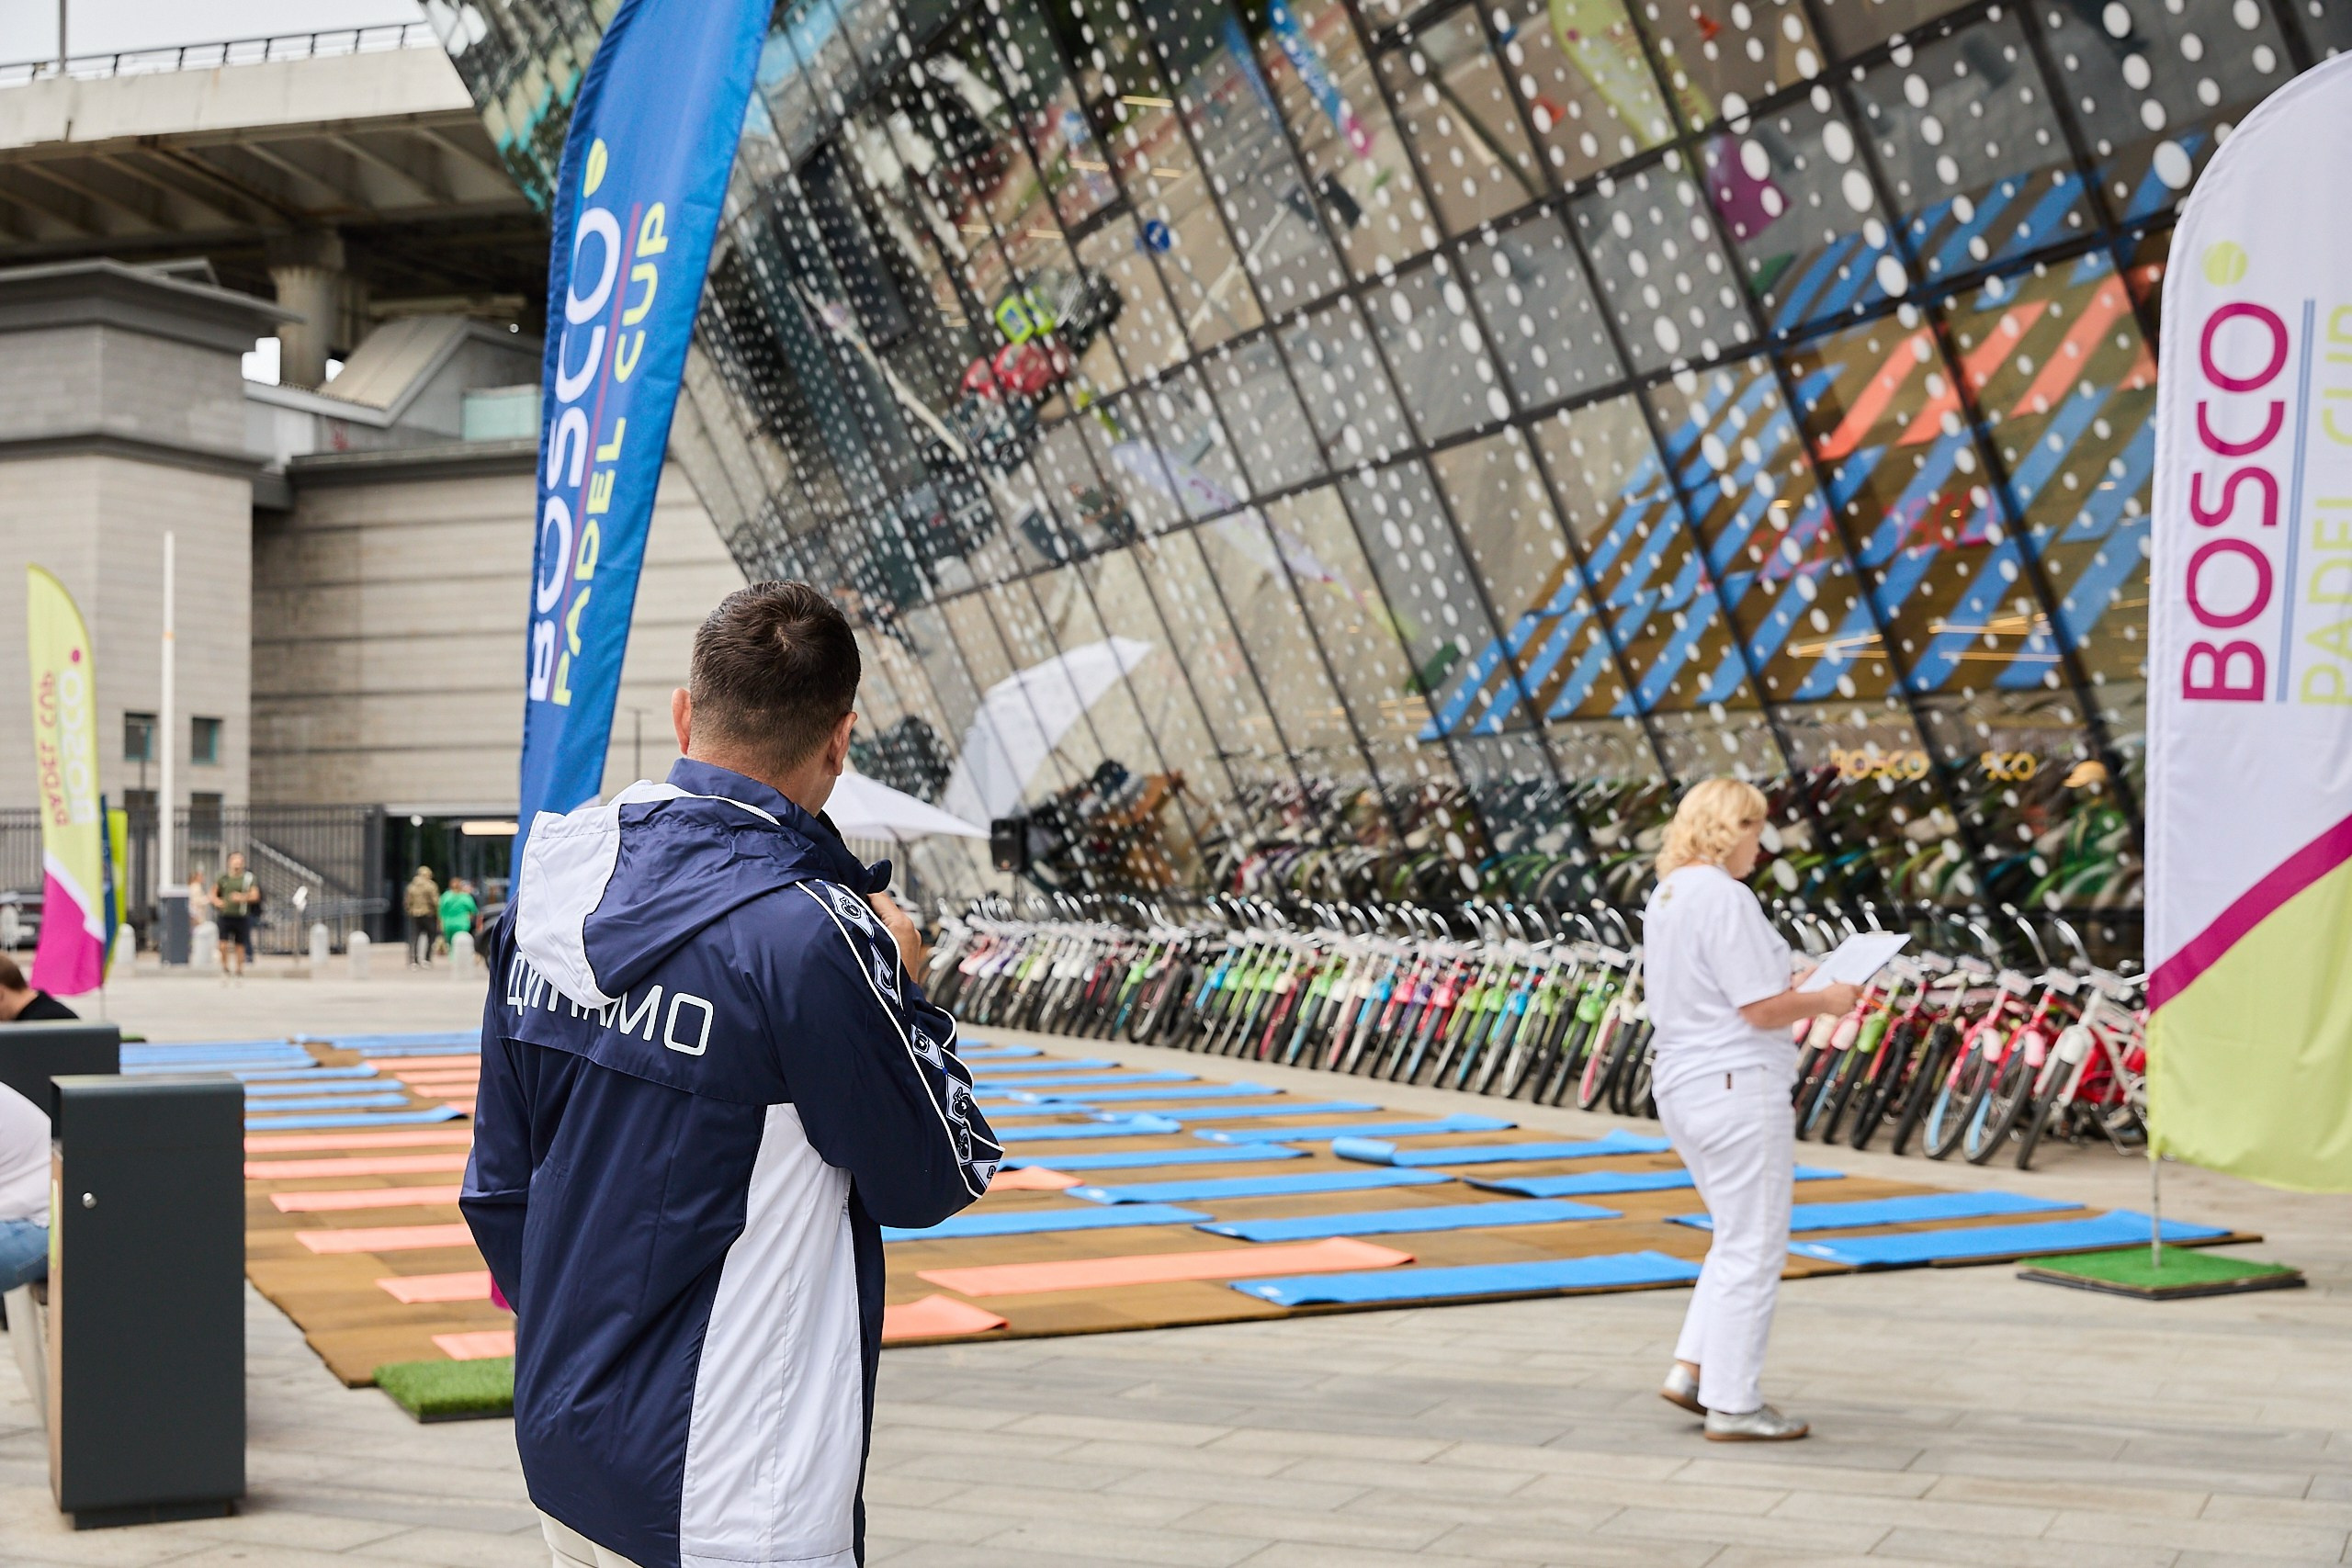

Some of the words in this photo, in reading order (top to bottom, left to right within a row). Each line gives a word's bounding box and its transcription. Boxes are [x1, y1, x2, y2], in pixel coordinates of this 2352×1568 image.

[530, 207, 621, 702] BOSCO
[551, 416, 628, 707] PADEL
[614, 201, 669, 383] CUP
[2183, 301, 2289, 702] BOSCO
